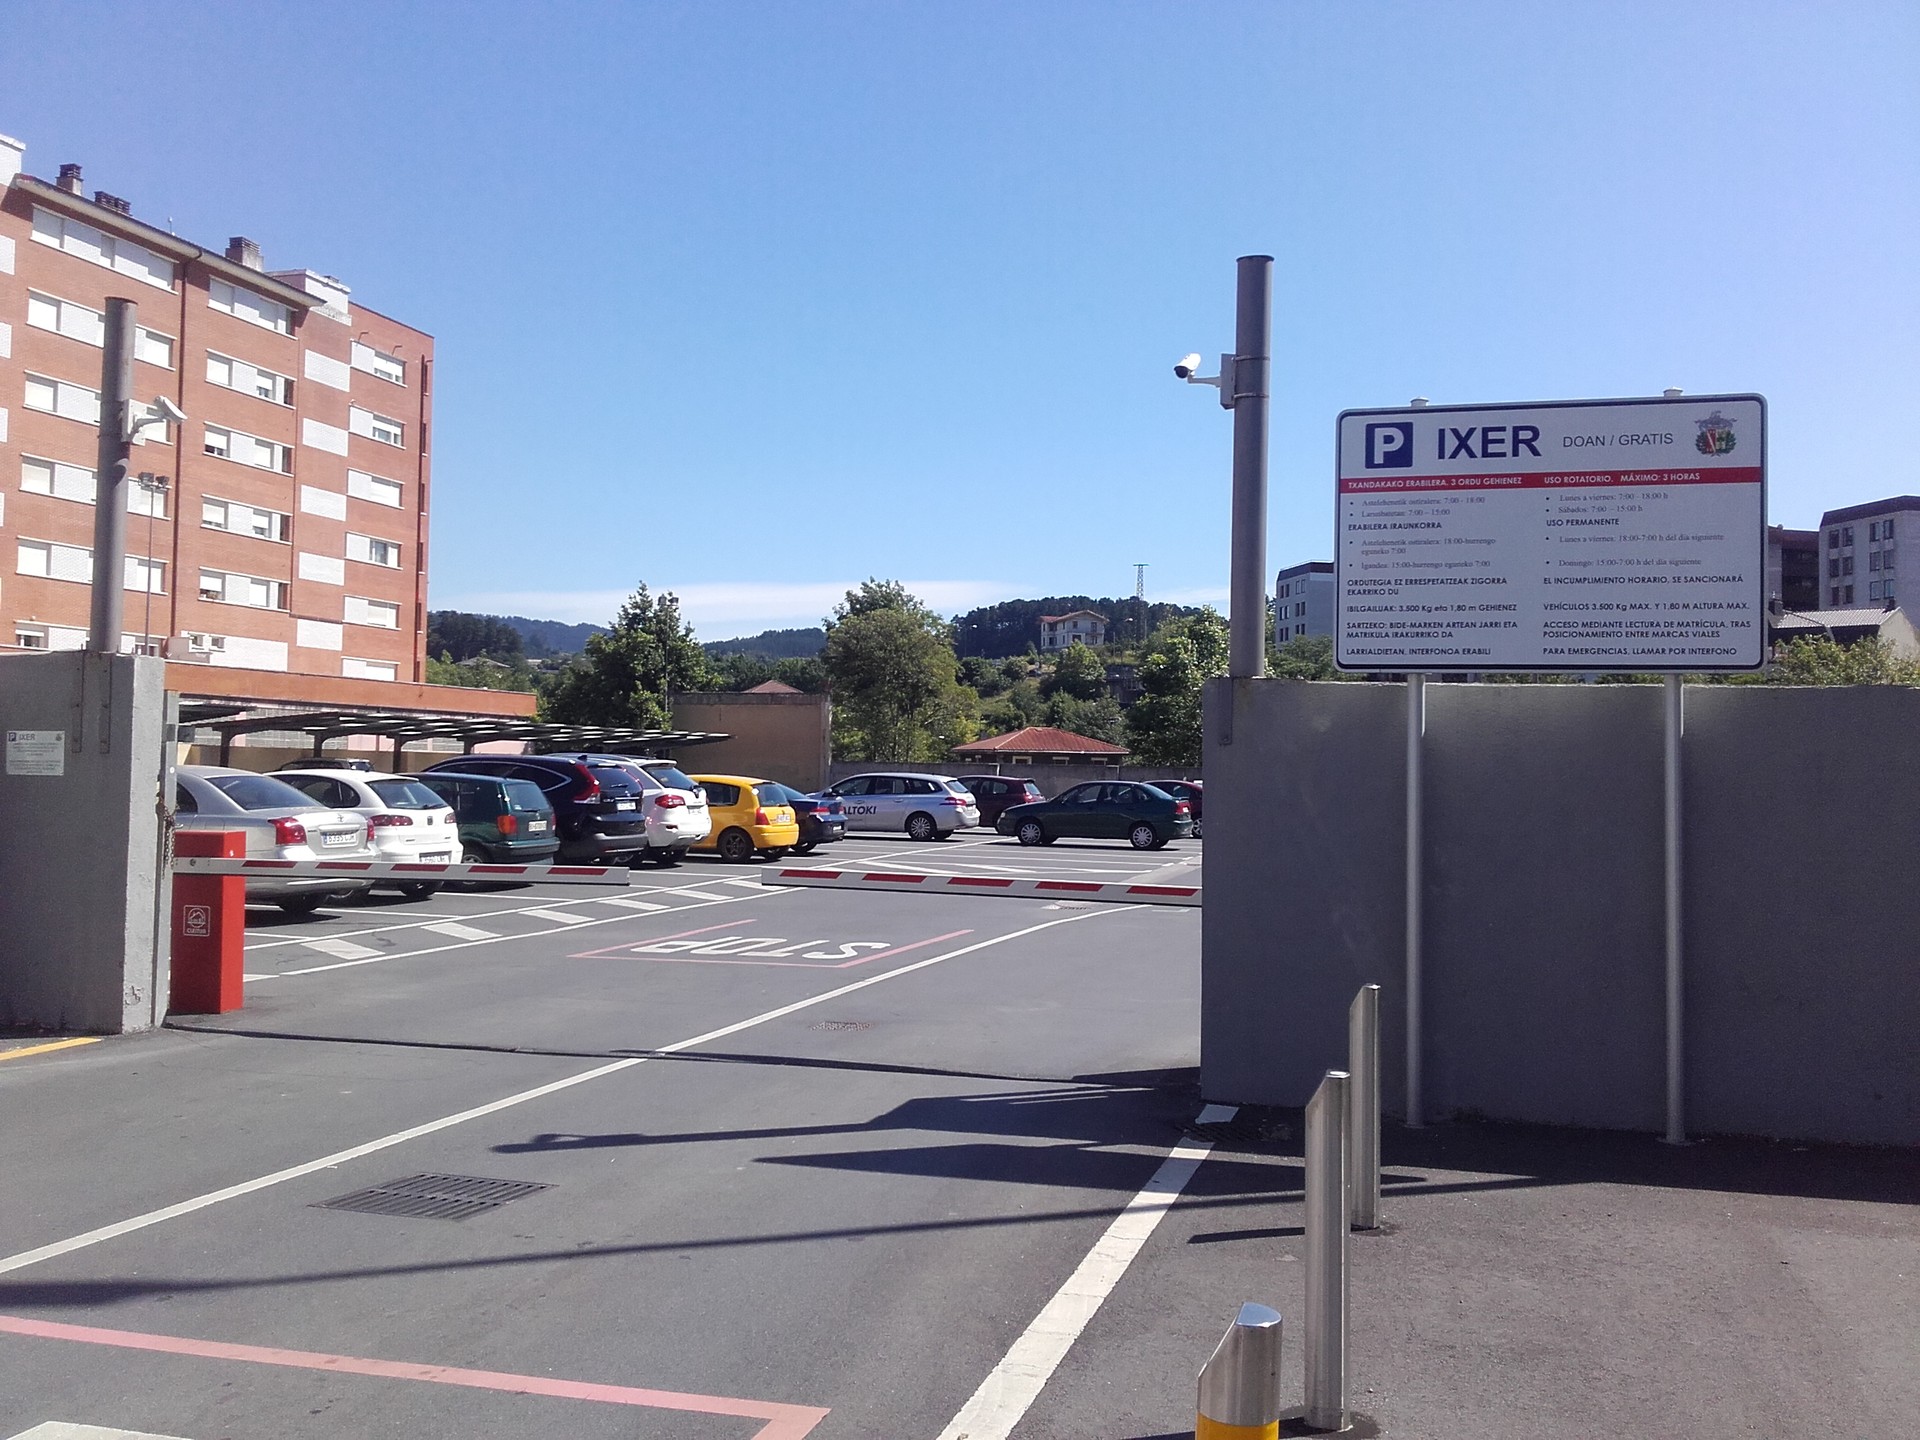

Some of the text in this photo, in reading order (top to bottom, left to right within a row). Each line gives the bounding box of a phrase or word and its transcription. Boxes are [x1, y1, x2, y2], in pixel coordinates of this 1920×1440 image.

[1438, 425, 1541, 460] IXER
[1563, 433, 1674, 448] DOAN / GRATIS
[1374, 427, 1403, 464] P
[1406, 479, 1448, 487] ERABILERA.
[1483, 477, 1522, 485] GEHIENEZ
[1544, 476, 1561, 484] USO
[1560, 494, 1581, 502] Lunes
[1390, 522, 1442, 530] IRAUNKORRA
[1566, 518, 1619, 526] PERMANENTE
[1554, 576, 1626, 584] INCUMPLIMIENTO
[1684, 574, 1743, 583] SANCIONARÁ
[1422, 605, 1432, 613] Kg
[1544, 602, 1589, 611] VEHÍCULOS
[1592, 603, 1614, 611] 3.500
[1616, 603, 1627, 612] Kg
[1726, 602, 1750, 610] MAX.
[1692, 630, 1720, 638] VIALES
[19, 733, 35, 741] IXER
[630, 936, 890, 959] STOP
